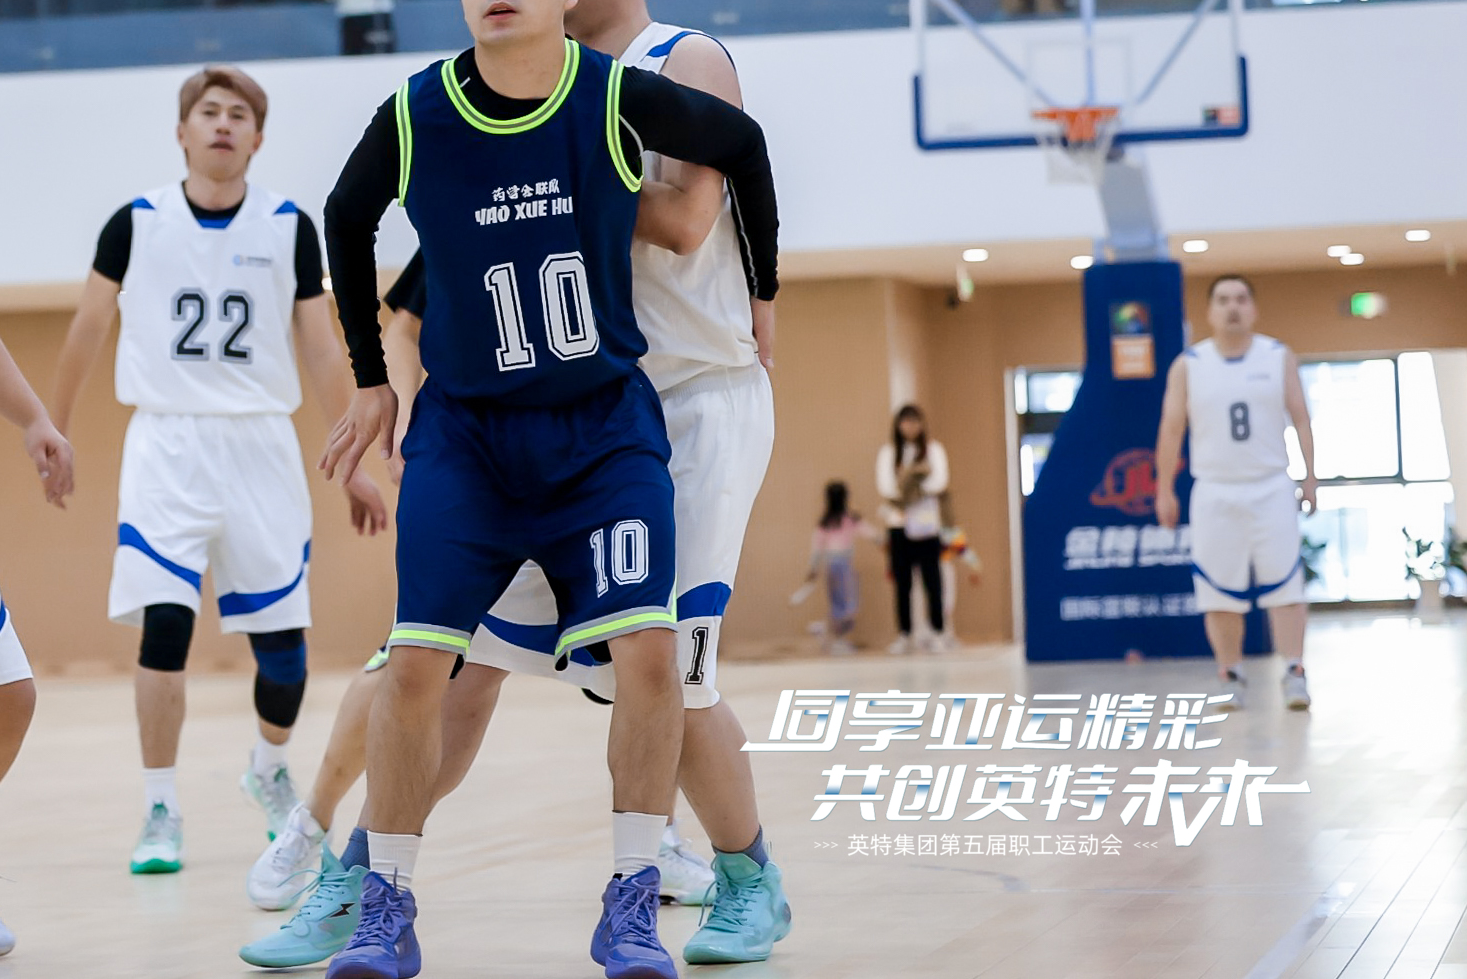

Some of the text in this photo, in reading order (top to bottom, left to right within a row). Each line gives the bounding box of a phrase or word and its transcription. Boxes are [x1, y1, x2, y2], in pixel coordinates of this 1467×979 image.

[475, 196, 573, 226] YAO XUE HU
[170, 287, 255, 365] 22
[484, 251, 600, 372] 10
[1228, 402, 1251, 442] 8
[589, 519, 649, 599] 10
[684, 626, 709, 685] 1
